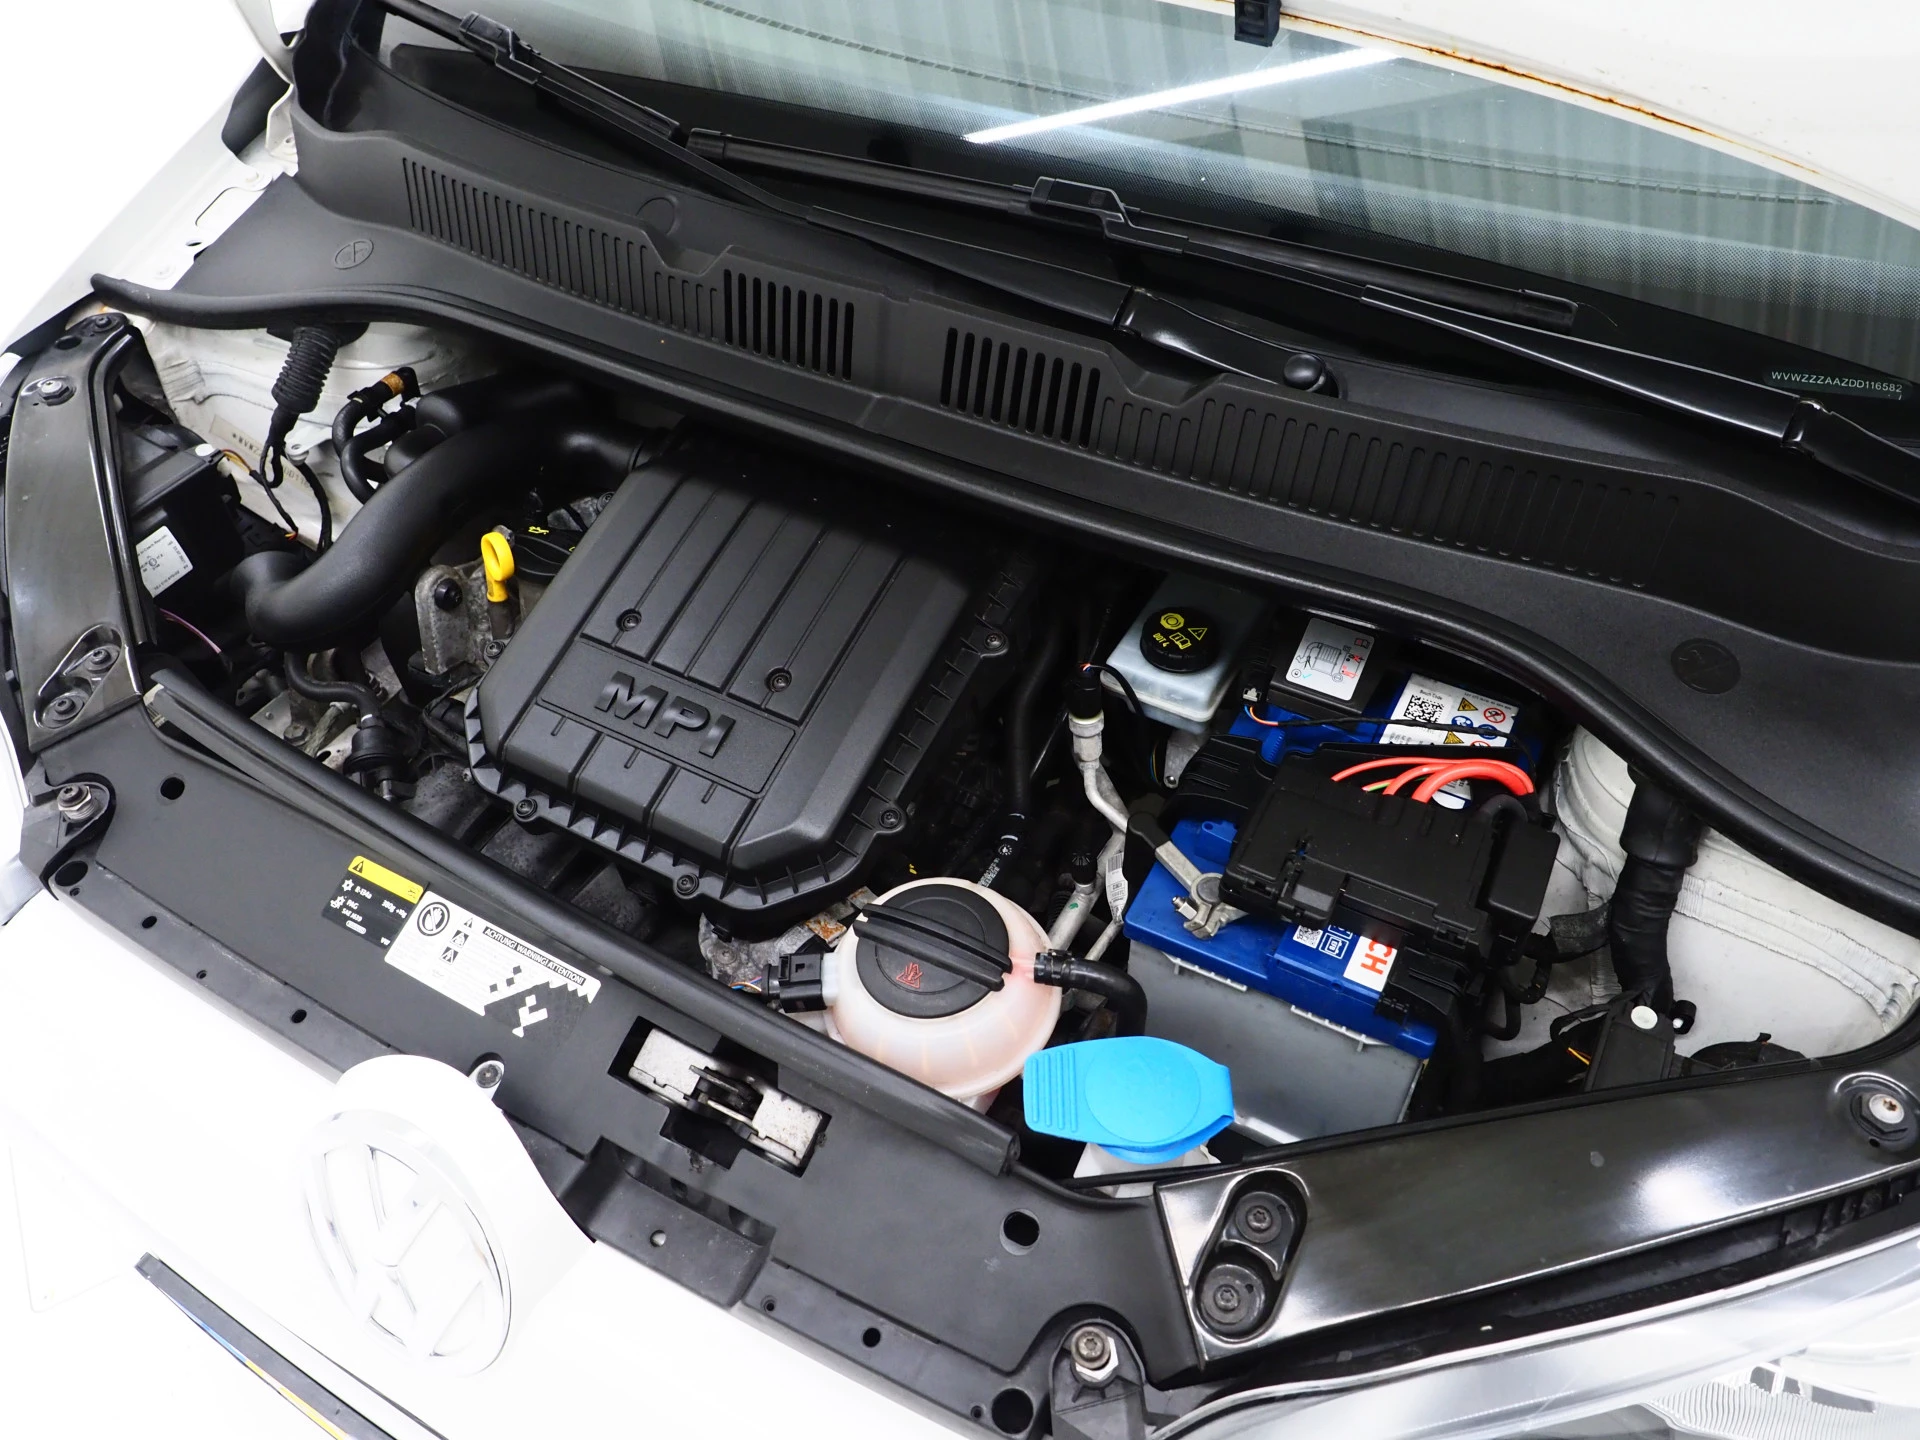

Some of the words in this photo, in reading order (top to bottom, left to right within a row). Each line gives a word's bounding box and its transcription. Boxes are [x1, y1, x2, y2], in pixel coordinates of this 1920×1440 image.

[1771, 371, 1903, 393] WVWZZZAAZDD116582
[594, 671, 736, 759] MPI
[341, 908, 352, 917] SAE
[346, 899, 359, 910] PAG
[485, 928, 517, 949] ACHTUNG!
[516, 944, 549, 966] WARNING!
[547, 960, 584, 984] ATTENTION!
